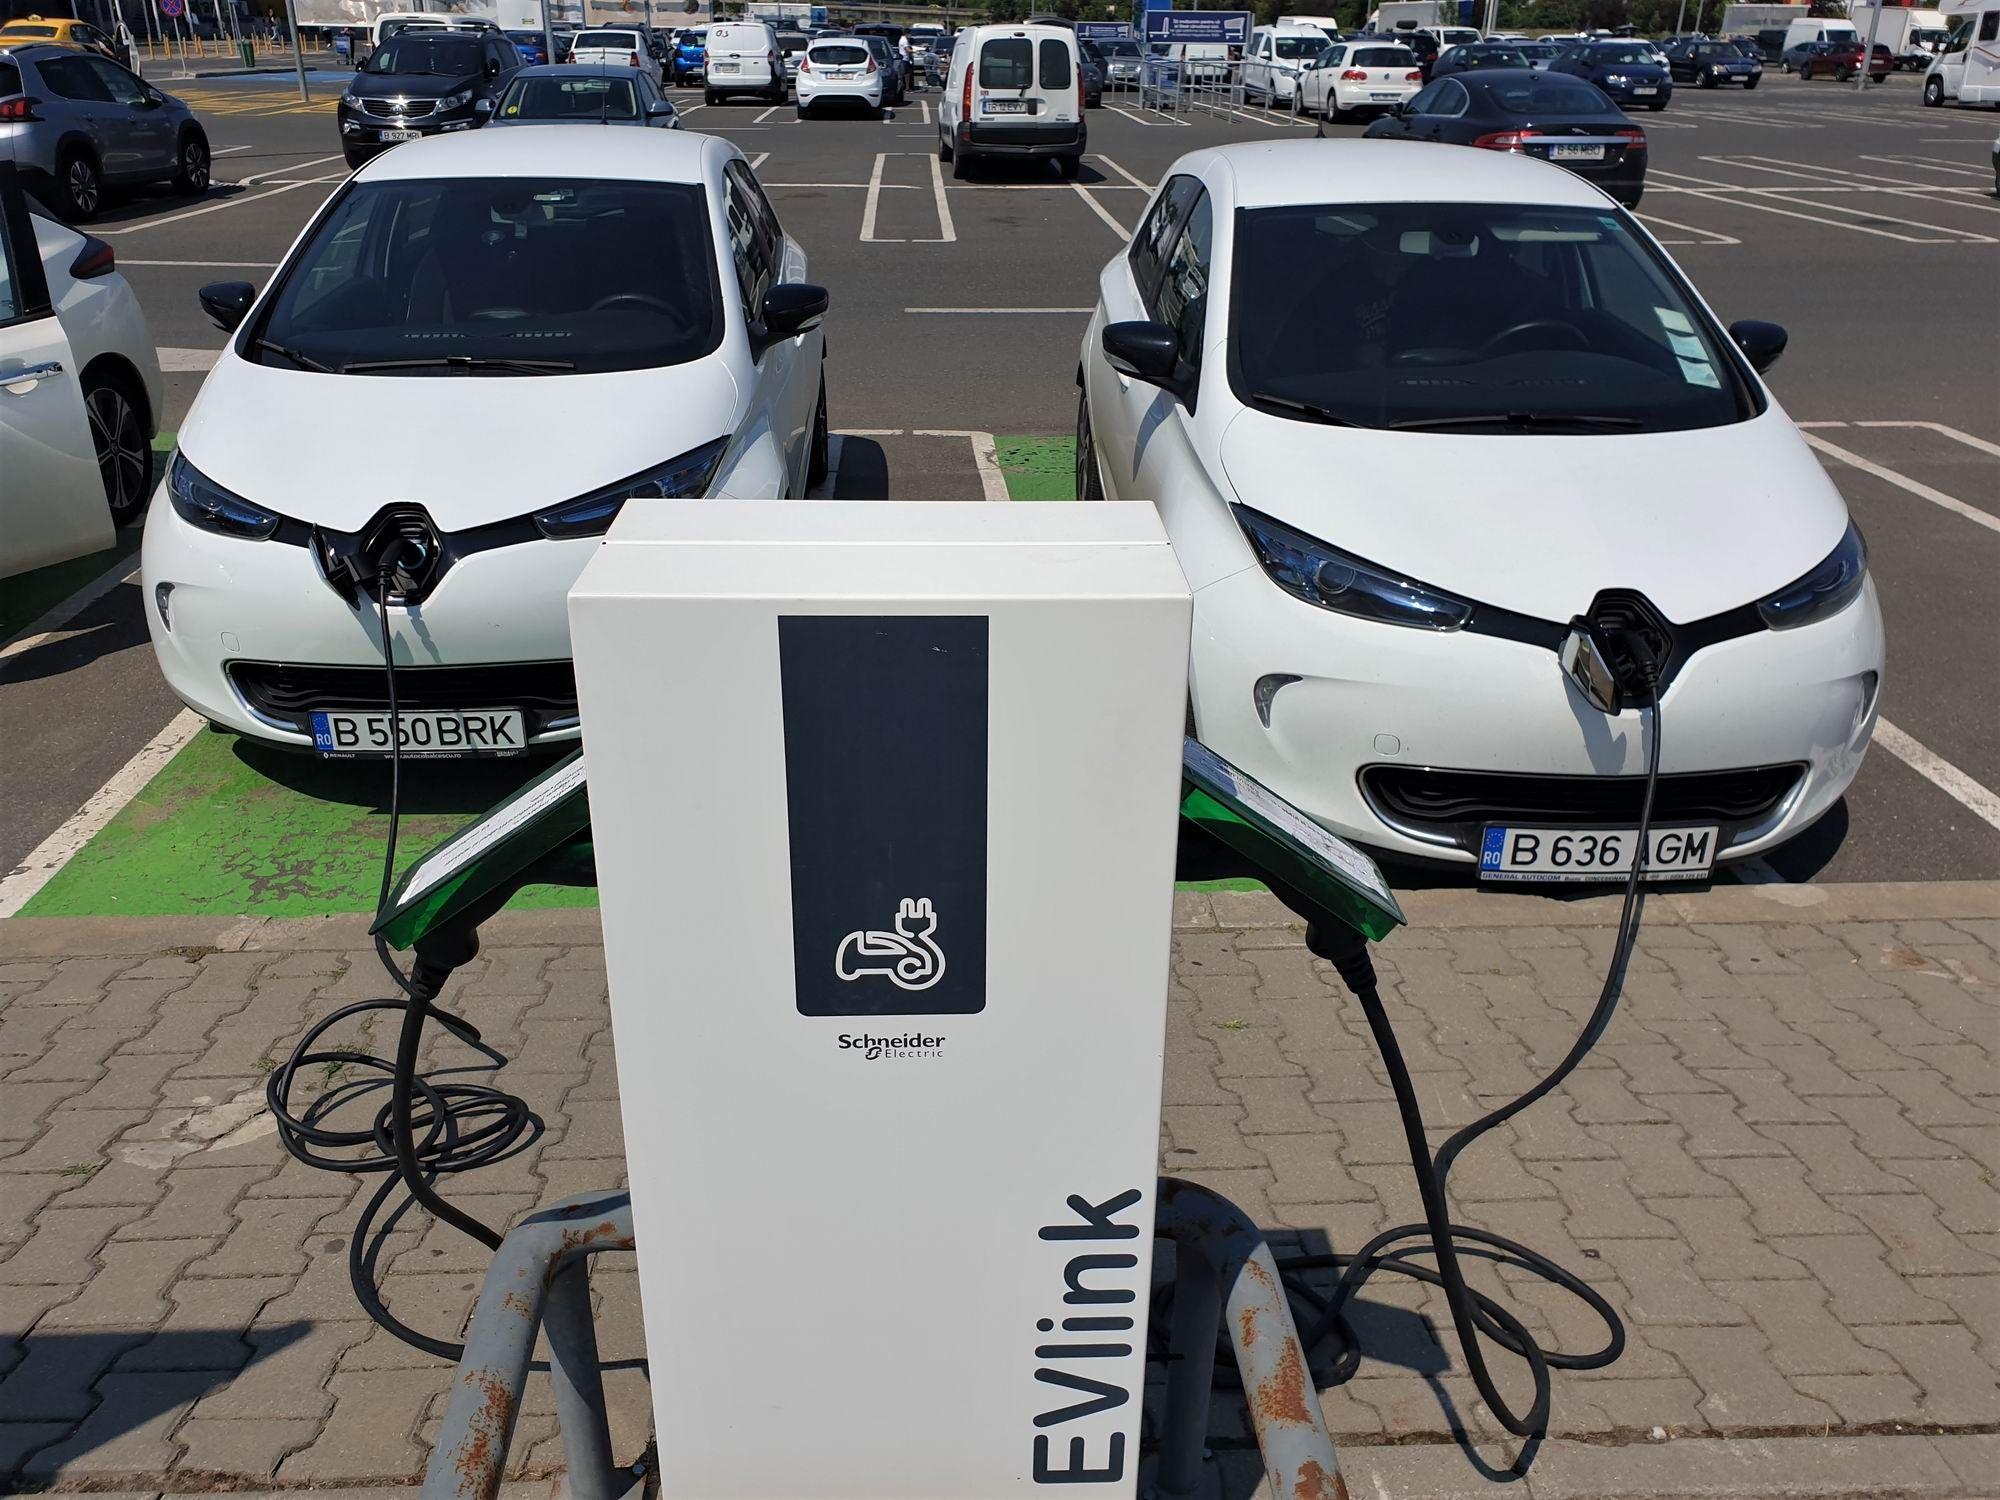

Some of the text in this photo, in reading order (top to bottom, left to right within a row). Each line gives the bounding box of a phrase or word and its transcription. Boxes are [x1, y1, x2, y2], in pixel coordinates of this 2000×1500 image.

[383, 131, 390, 140] B
[333, 715, 516, 747] B 550 BRK
[316, 733, 331, 745] RO
[1510, 833, 1540, 865] B
[1550, 835, 1622, 867] 636
[1482, 851, 1500, 865] RO
[1482, 872, 1520, 880] GENERAL
[1521, 873, 1561, 881] AUTOCOM
[838, 1033, 946, 1049] Schneider
[885, 1049, 943, 1059] Electric
[1032, 1188, 1143, 1484] EVlink
